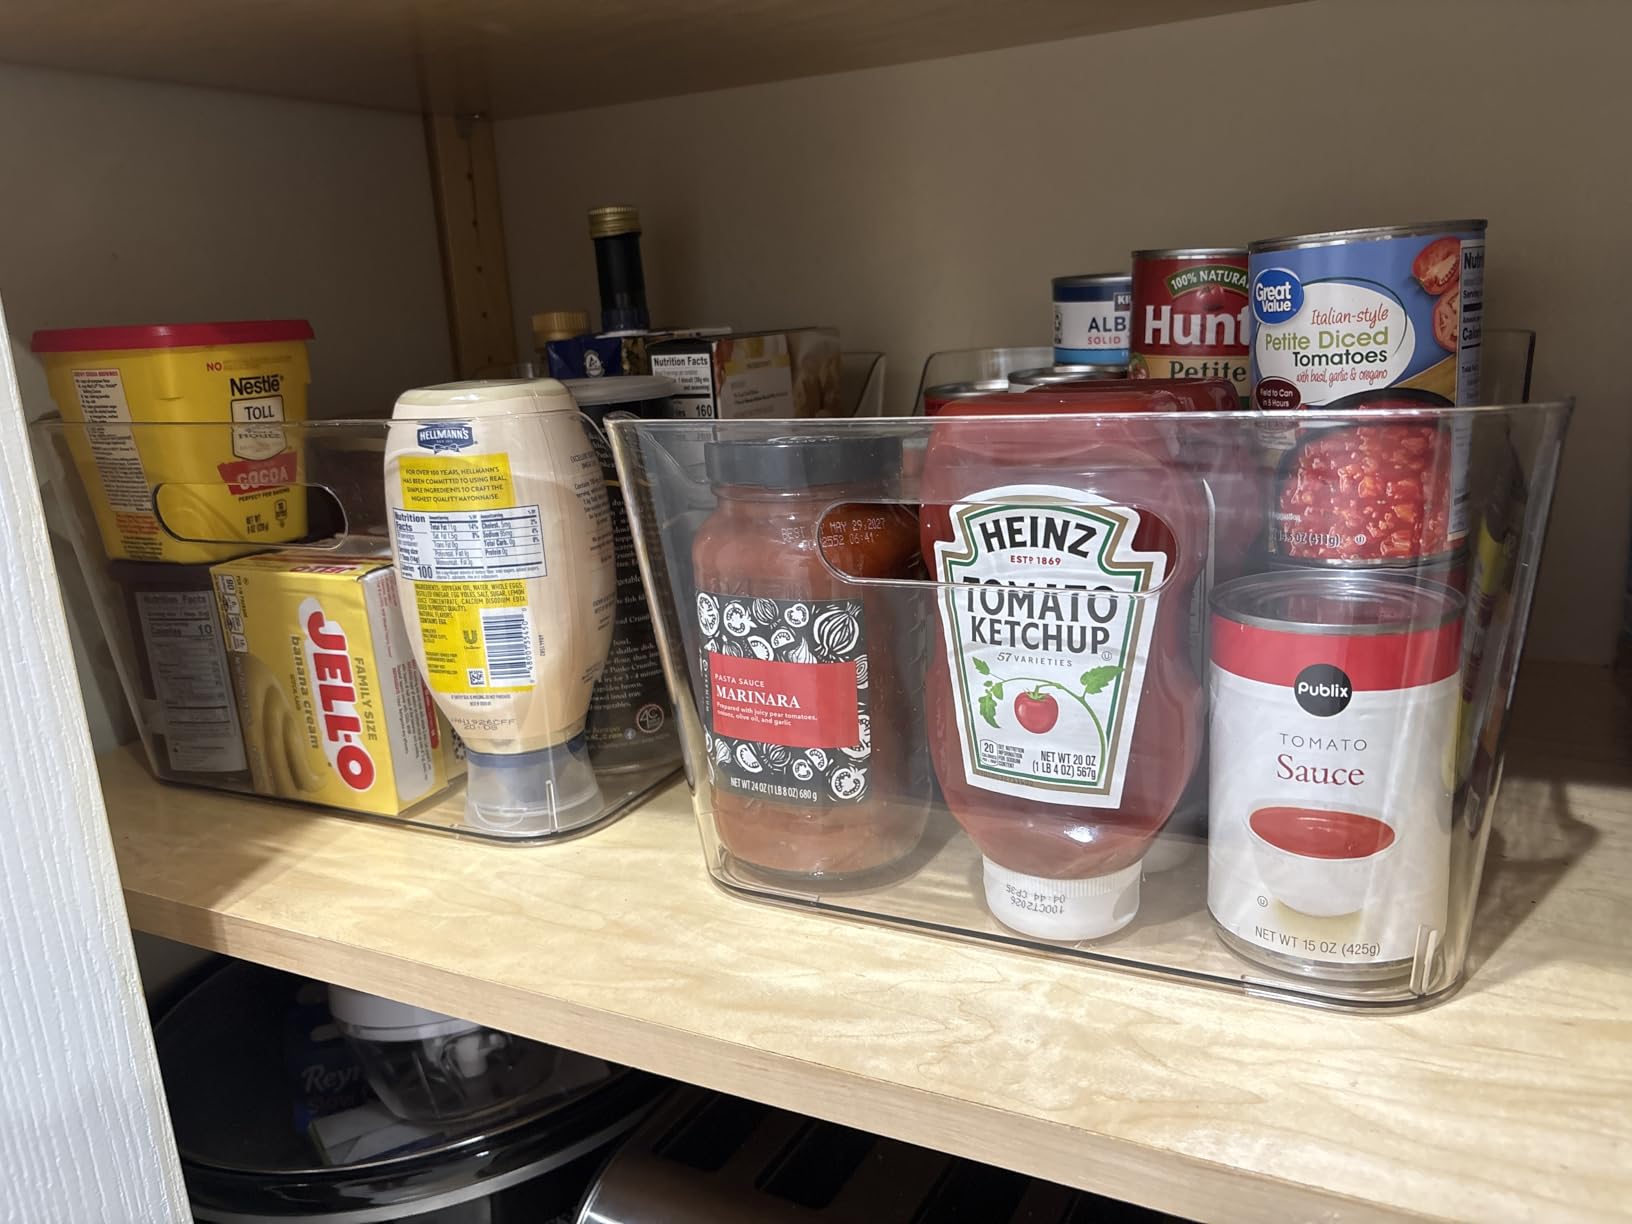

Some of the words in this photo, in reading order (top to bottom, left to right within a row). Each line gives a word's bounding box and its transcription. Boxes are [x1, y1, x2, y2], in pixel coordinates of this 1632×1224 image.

[1170, 272, 1197, 290] 100%
[1256, 281, 1292, 301] Great
[1261, 300, 1292, 313] Value
[1311, 301, 1389, 329] Italian-style
[1087, 336, 1121, 345] SOLID
[1265, 331, 1311, 351] Petite
[1318, 326, 1389, 349] Diced
[206, 362, 222, 371] NO
[654, 357, 686, 367] Nutrition
[687, 356, 708, 366] Facts
[1292, 349, 1388, 367] Tomatoes
[1169, 360, 1247, 382] Petite
[1350, 367, 1357, 381] &
[1359, 369, 1388, 385] oregano
[229, 374, 280, 396] Nestlé
[1279, 388, 1293, 397] Can
[244, 405, 275, 420] TOLL
[696, 404, 712, 417] 160
[420, 428, 469, 441] HELLMANN'S
[237, 466, 289, 490] COCOA
[440, 468, 460, 476] YEARS,
[461, 467, 500, 475] HELLMANN'S
[433, 496, 458, 504] QUALITY
[395, 511, 426, 523] Nutrition
[781, 526, 805, 540] BEST
[829, 521, 847, 532] MAY
[979, 516, 1098, 559] HEINZ
[1036, 556, 1062, 566] 1869
[417, 566, 433, 578] 100
[963, 576, 1119, 624] TOMATO
[198, 623, 213, 634] 10
[971, 616, 1110, 655] KETCHUP
[997, 652, 1012, 661] 57
[1013, 654, 1073, 668] VARIETIES
[714, 673, 737, 684] PASTA
[739, 679, 765, 688] SAUCE
[292, 636, 309, 701] banana
[304, 700, 319, 750] cream
[716, 684, 801, 709] MARINARA
[1298, 682, 1348, 698] Publix
[355, 657, 372, 710] FAMILY
[364, 711, 378, 741] SIZE
[716, 701, 740, 712] Prepared
[740, 706, 754, 714] with
[754, 708, 769, 717] juicy
[750, 715, 761, 723] oil,
[774, 718, 792, 727] garlic
[984, 742, 994, 754] 20
[1280, 733, 1367, 751] TOMATO
[1041, 750, 1056, 760] NET
[1058, 752, 1071, 762] WT
[1073, 754, 1083, 766] 20
[1085, 755, 1096, 767] OZ
[1032, 760, 1039, 773] (1
[1042, 762, 1051, 774] LB
[1054, 764, 1059, 774] 4
[1060, 765, 1075, 778] OZ)
[1076, 766, 1096, 780] 567g
[1277, 753, 1365, 786] Sauce
[730, 776, 741, 787] NET
[741, 779, 751, 790] WT
[751, 781, 758, 791] 24
[759, 782, 767, 793] OZ
[767, 784, 774, 795] (1
[774, 785, 782, 796] LB
[782, 786, 787, 796] 8
[788, 787, 799, 799] OZ)
[799, 789, 812, 799] 680
[812, 791, 818, 802] g
[1255, 926, 1277, 942] NET
[1279, 933, 1299, 948] WT
[1303, 940, 1315, 952] 15
[1320, 942, 1337, 953] OZ
[1342, 942, 1380, 957] (425g)
